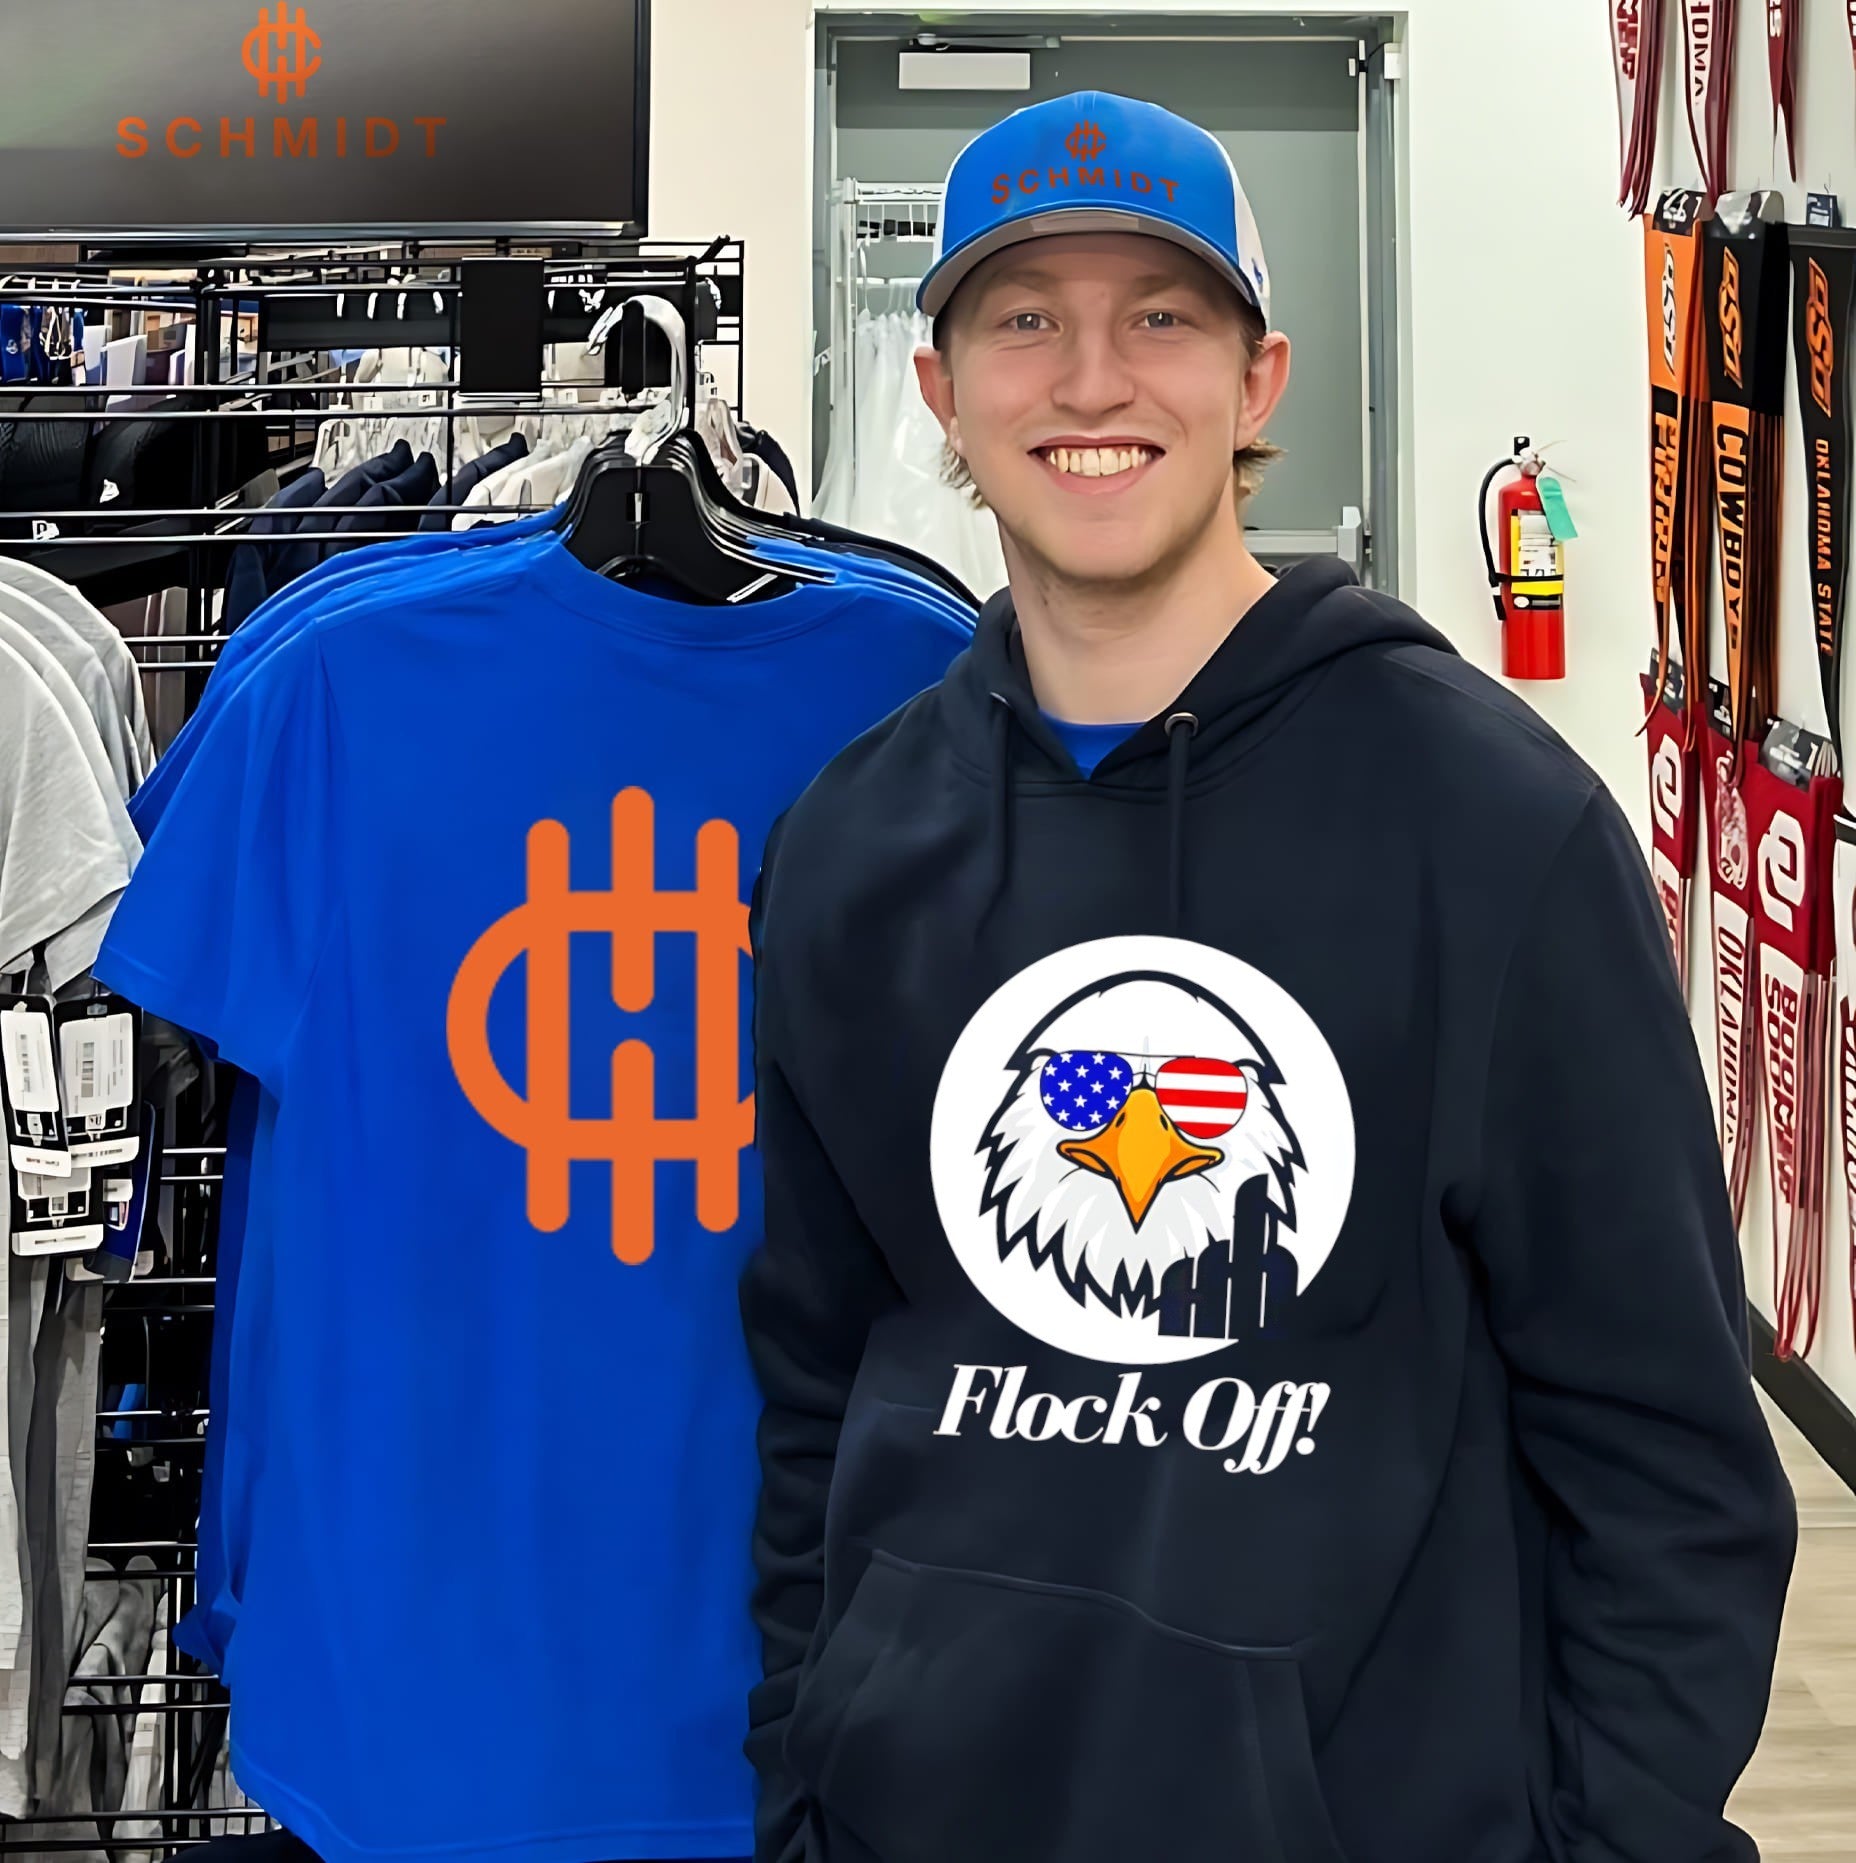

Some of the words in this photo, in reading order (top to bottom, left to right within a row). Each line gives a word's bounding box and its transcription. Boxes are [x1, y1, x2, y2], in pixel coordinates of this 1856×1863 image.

[115, 117, 448, 159] SCHMIDT
[991, 166, 1179, 205] SCHMIDT
[1718, 245, 1744, 390] OSU
[1807, 256, 1834, 419] OSU
[1814, 438, 1832, 570] OKLAHOMA
[1718, 926, 1746, 1144] OKLAHOMA
[933, 1364, 1168, 1448] Flock
[1182, 1377, 1331, 1475] Off!
